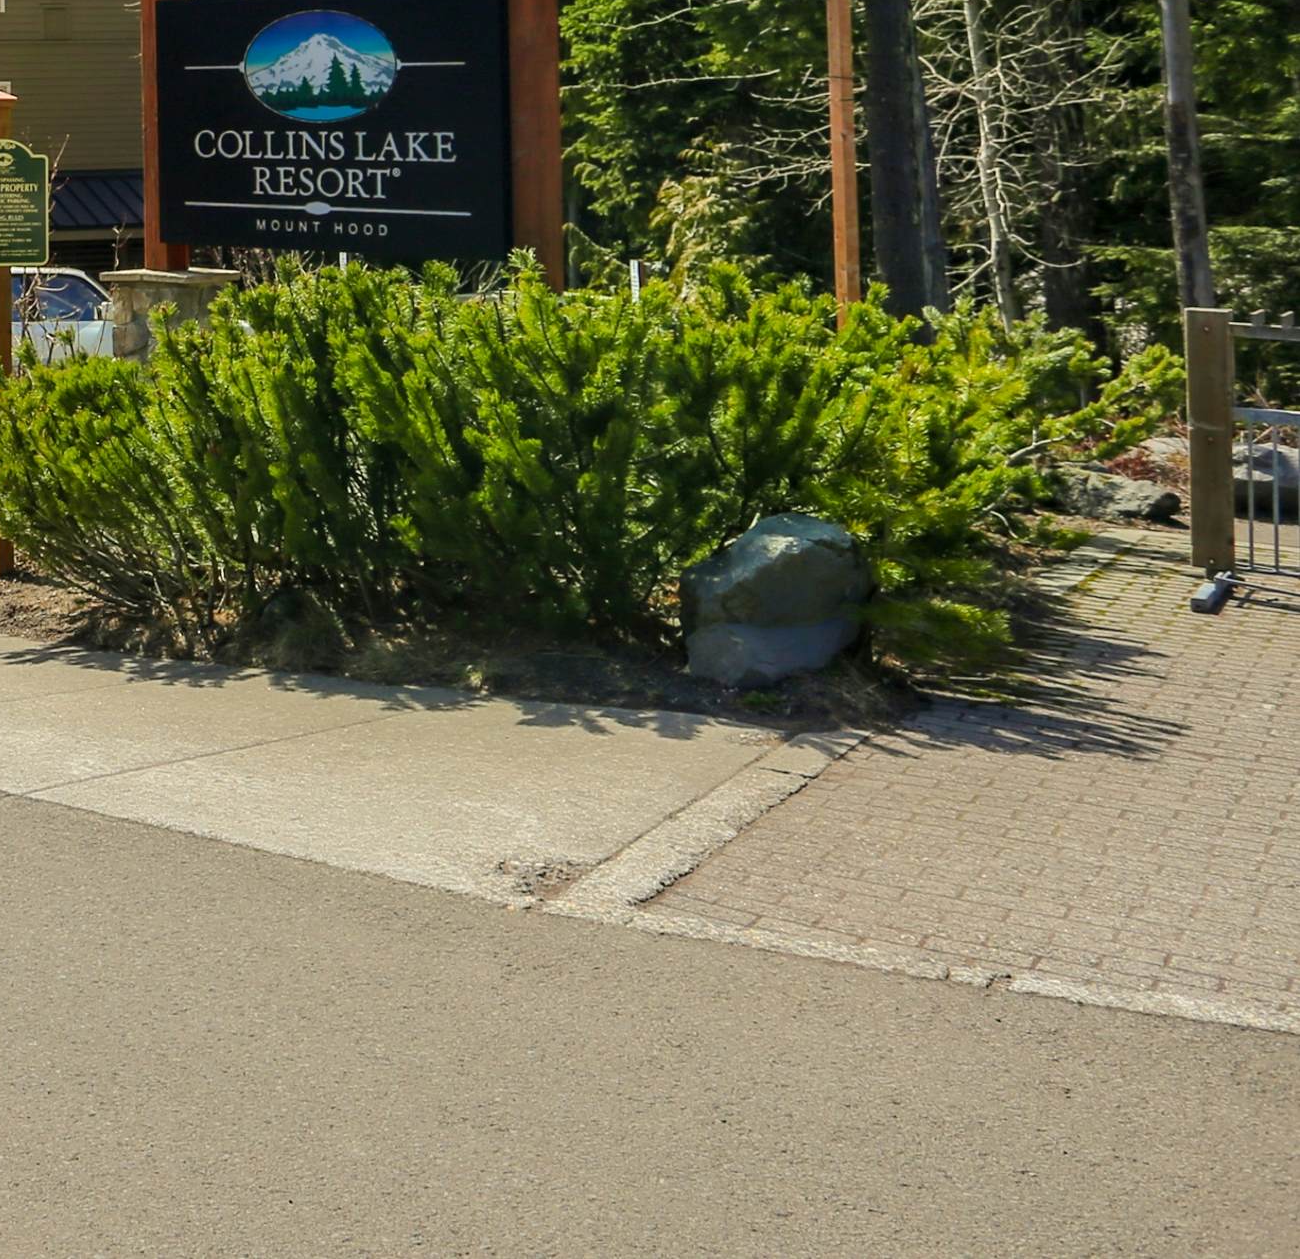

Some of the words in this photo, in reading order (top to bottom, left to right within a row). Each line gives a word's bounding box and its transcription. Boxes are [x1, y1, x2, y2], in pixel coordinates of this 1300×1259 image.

[194, 129, 346, 161] COLLINS
[354, 131, 457, 163] LAKE
[0, 183, 38, 192] PROPERTY
[255, 219, 321, 233] MOUNT
[334, 223, 388, 236] HOOD
